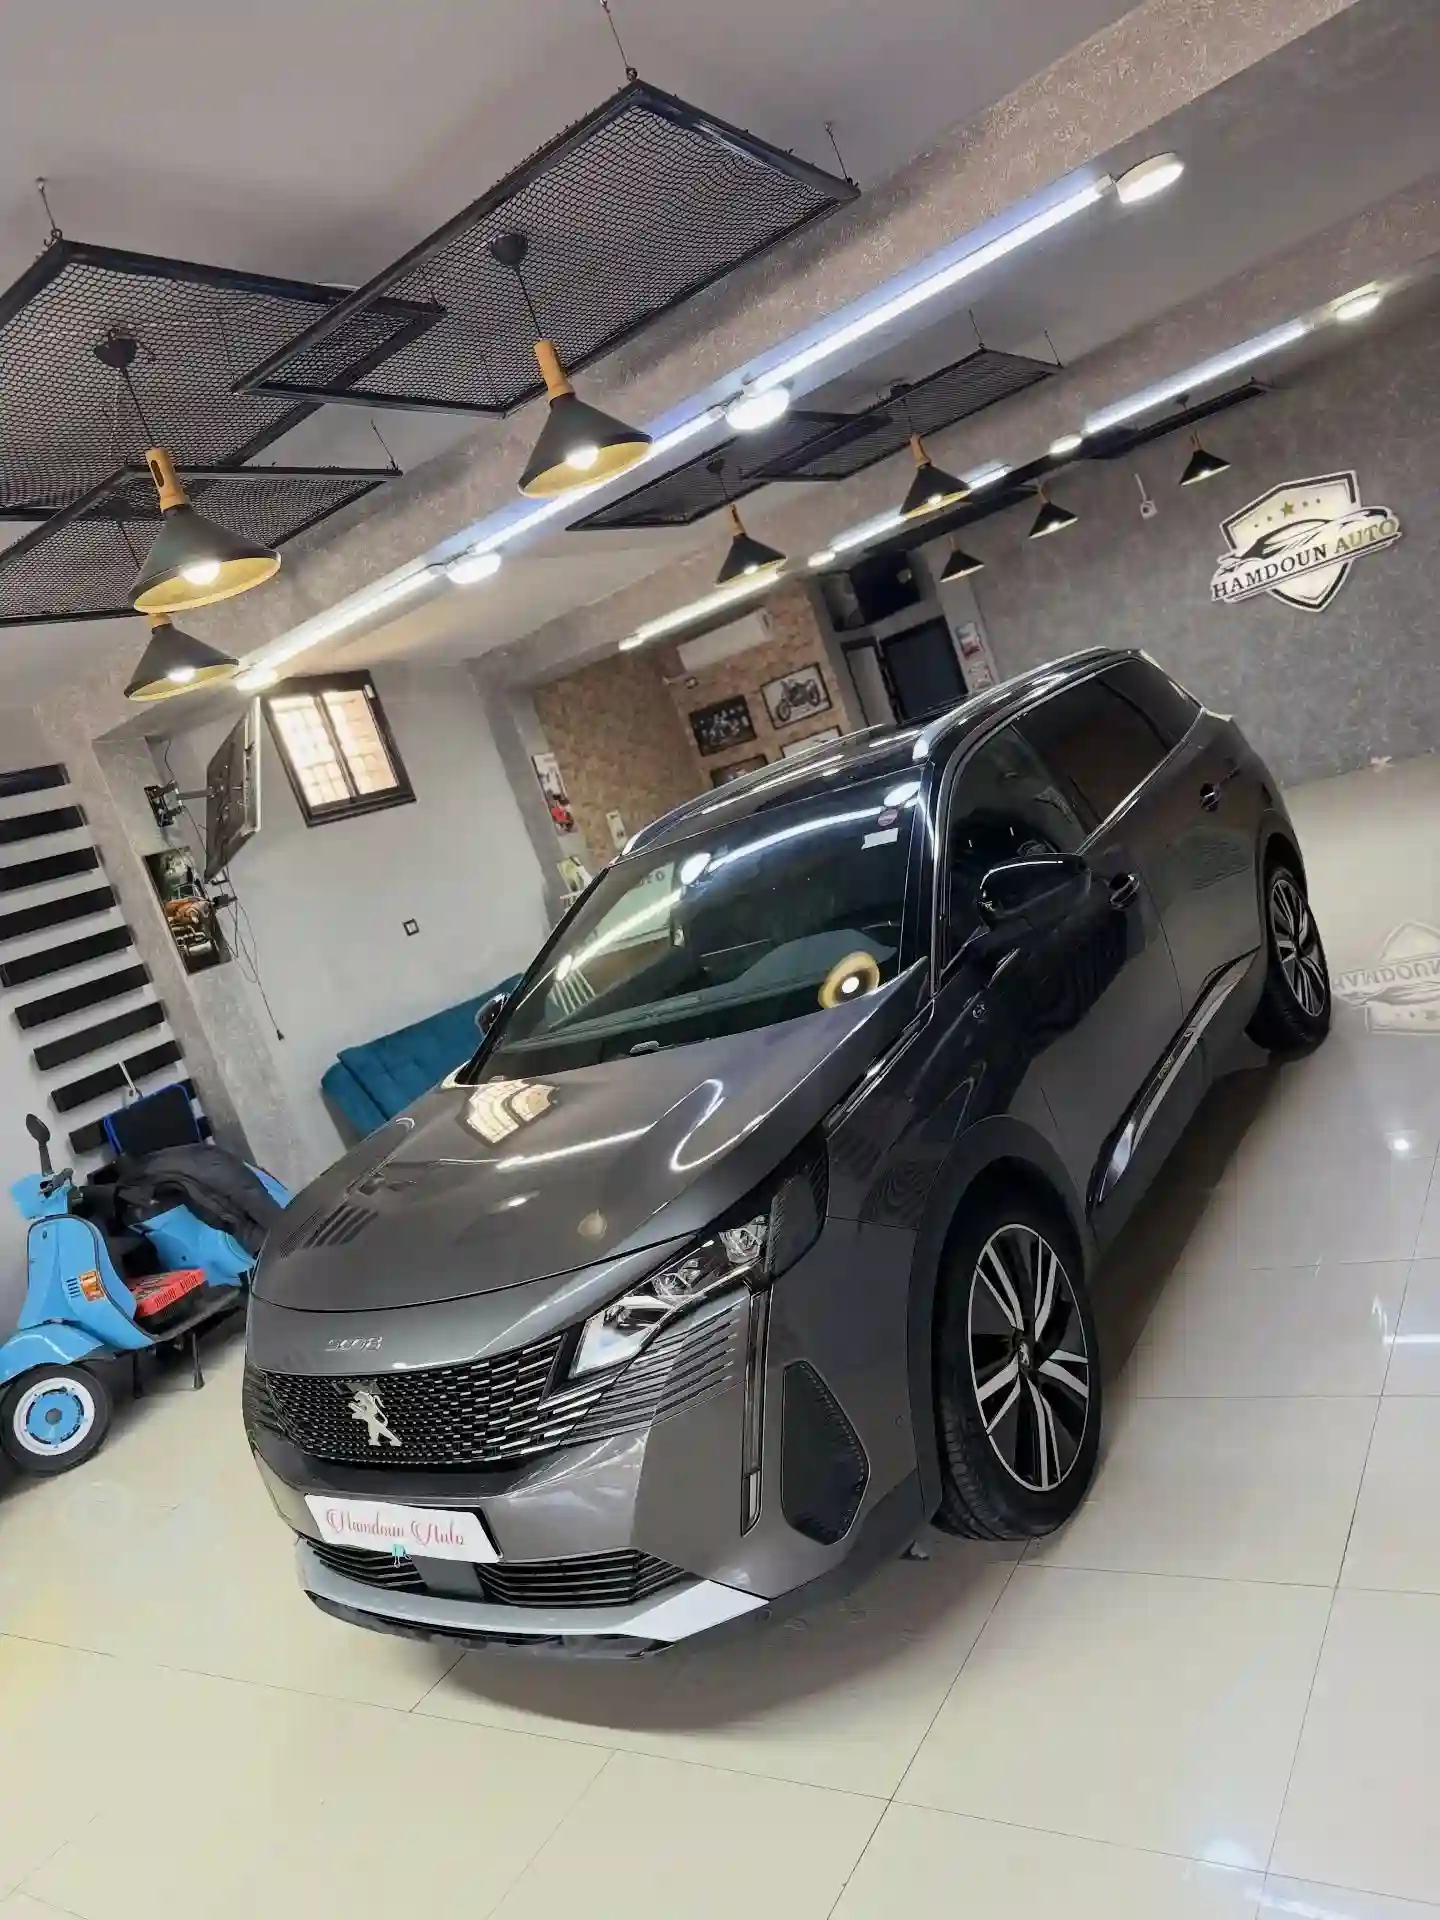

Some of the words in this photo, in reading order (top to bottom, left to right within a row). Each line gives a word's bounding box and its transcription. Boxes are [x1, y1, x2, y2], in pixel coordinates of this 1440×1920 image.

[1213, 543, 1328, 599] HAMDOUN
[1334, 519, 1397, 554] AUTO
[410, 1518, 465, 1547] Auto
